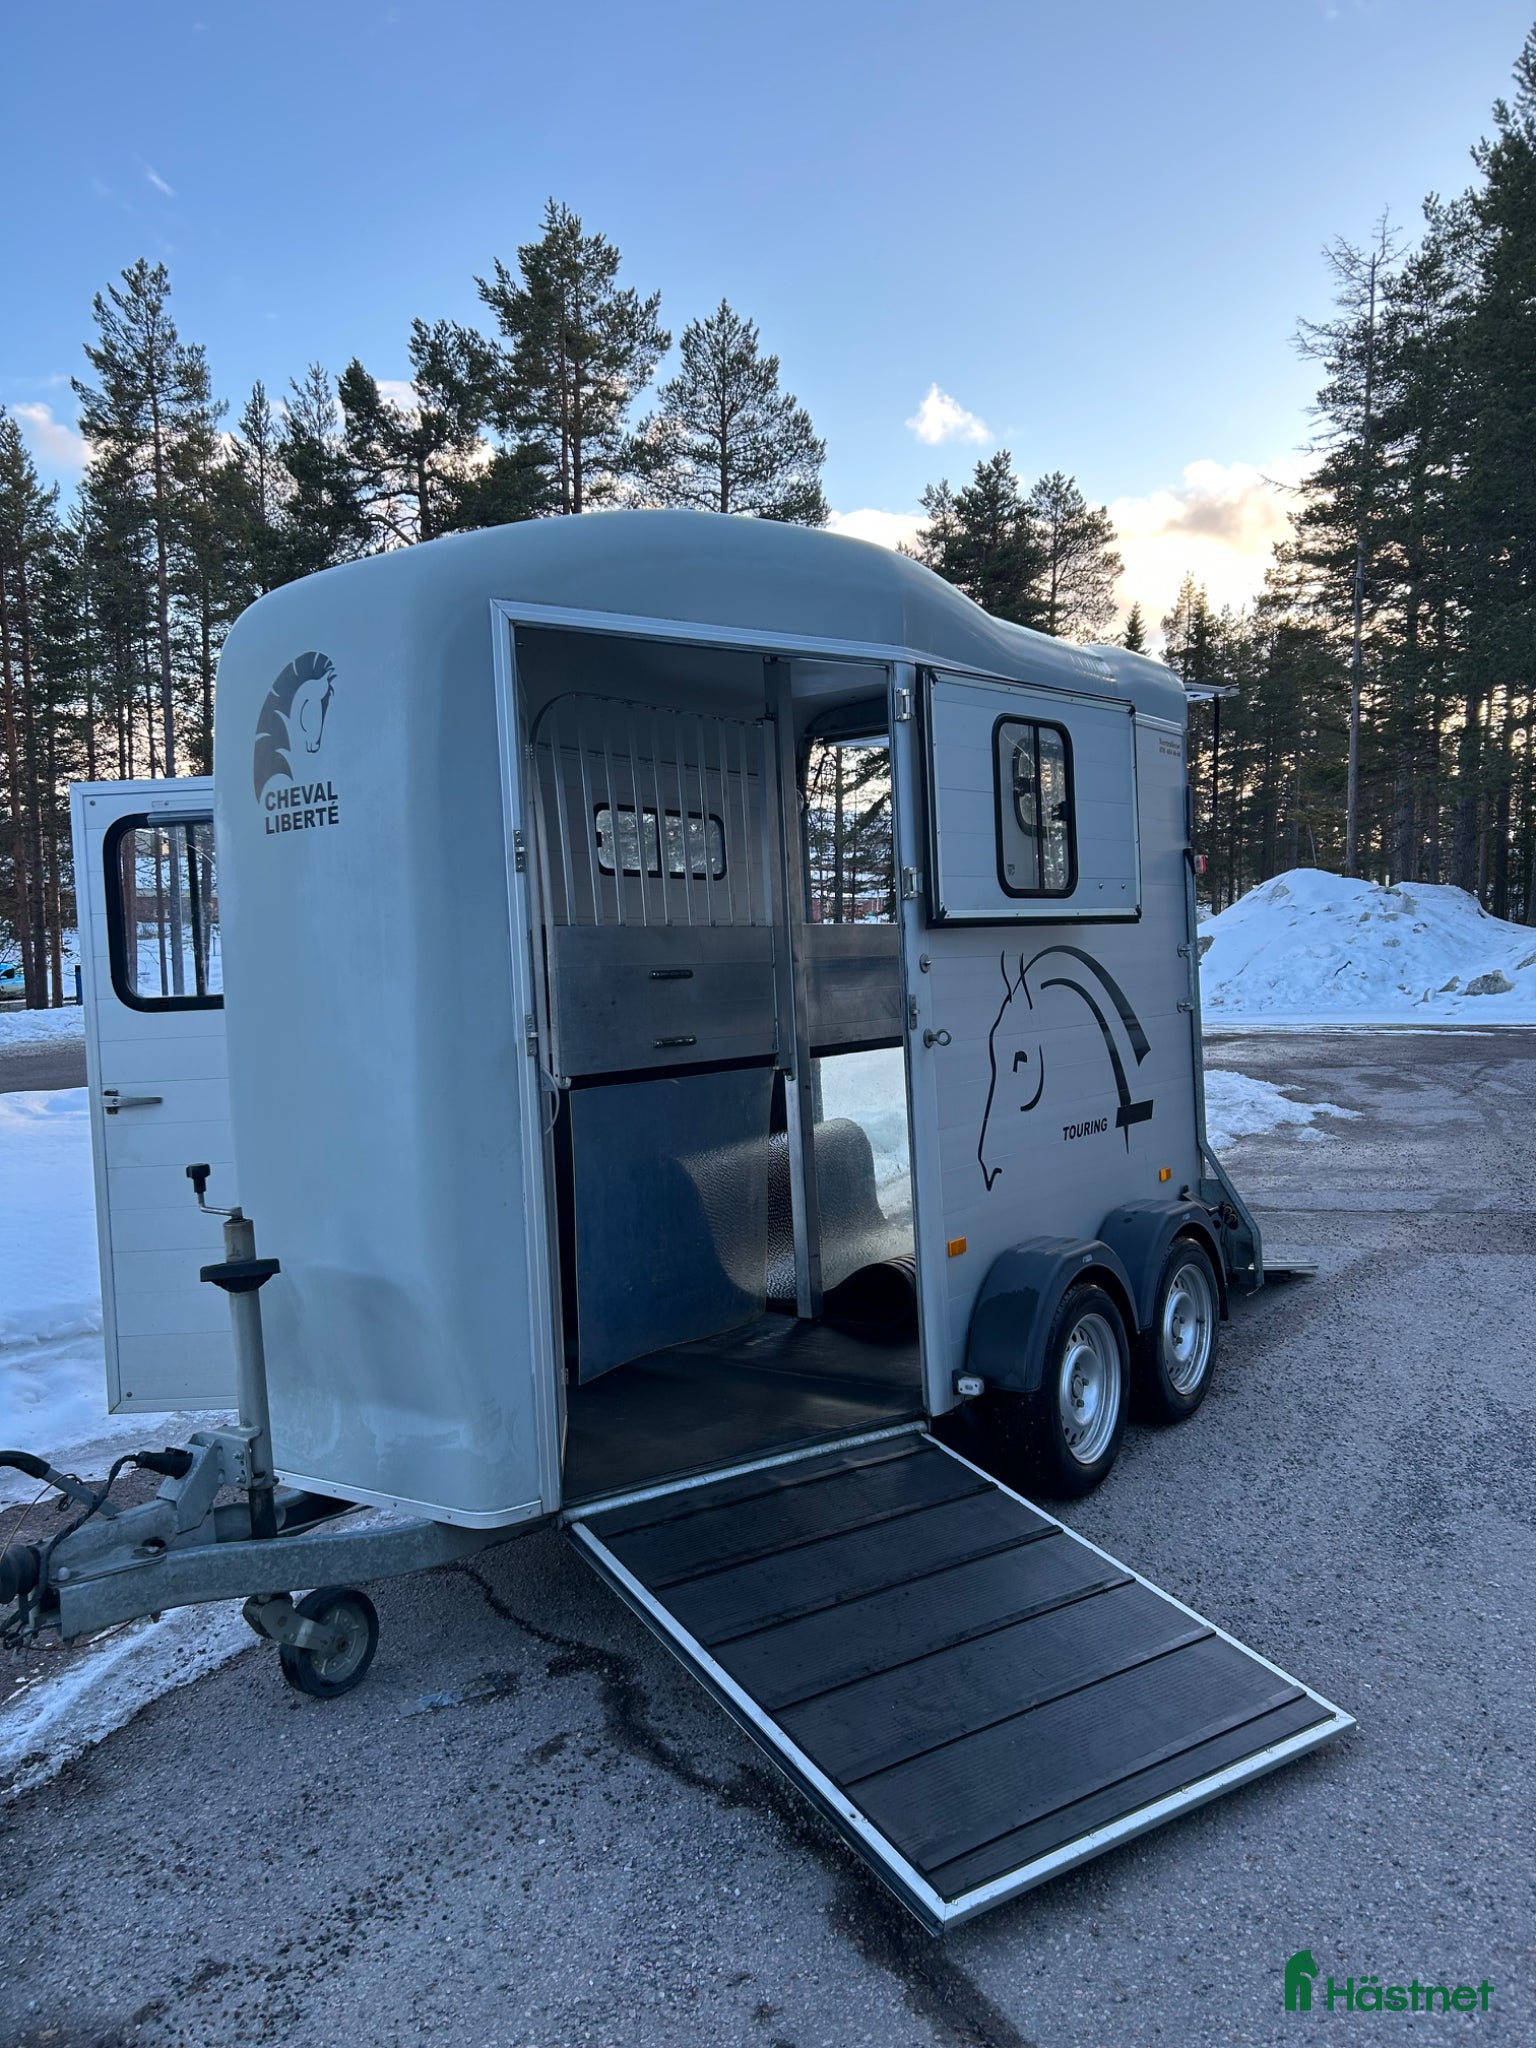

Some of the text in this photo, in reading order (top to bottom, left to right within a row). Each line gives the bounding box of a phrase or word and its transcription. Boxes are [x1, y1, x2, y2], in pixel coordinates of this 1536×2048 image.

[265, 781, 338, 811] CHEVAL
[265, 801, 339, 834] LIBERTÉ
[1063, 1118, 1107, 1141] TOURING
